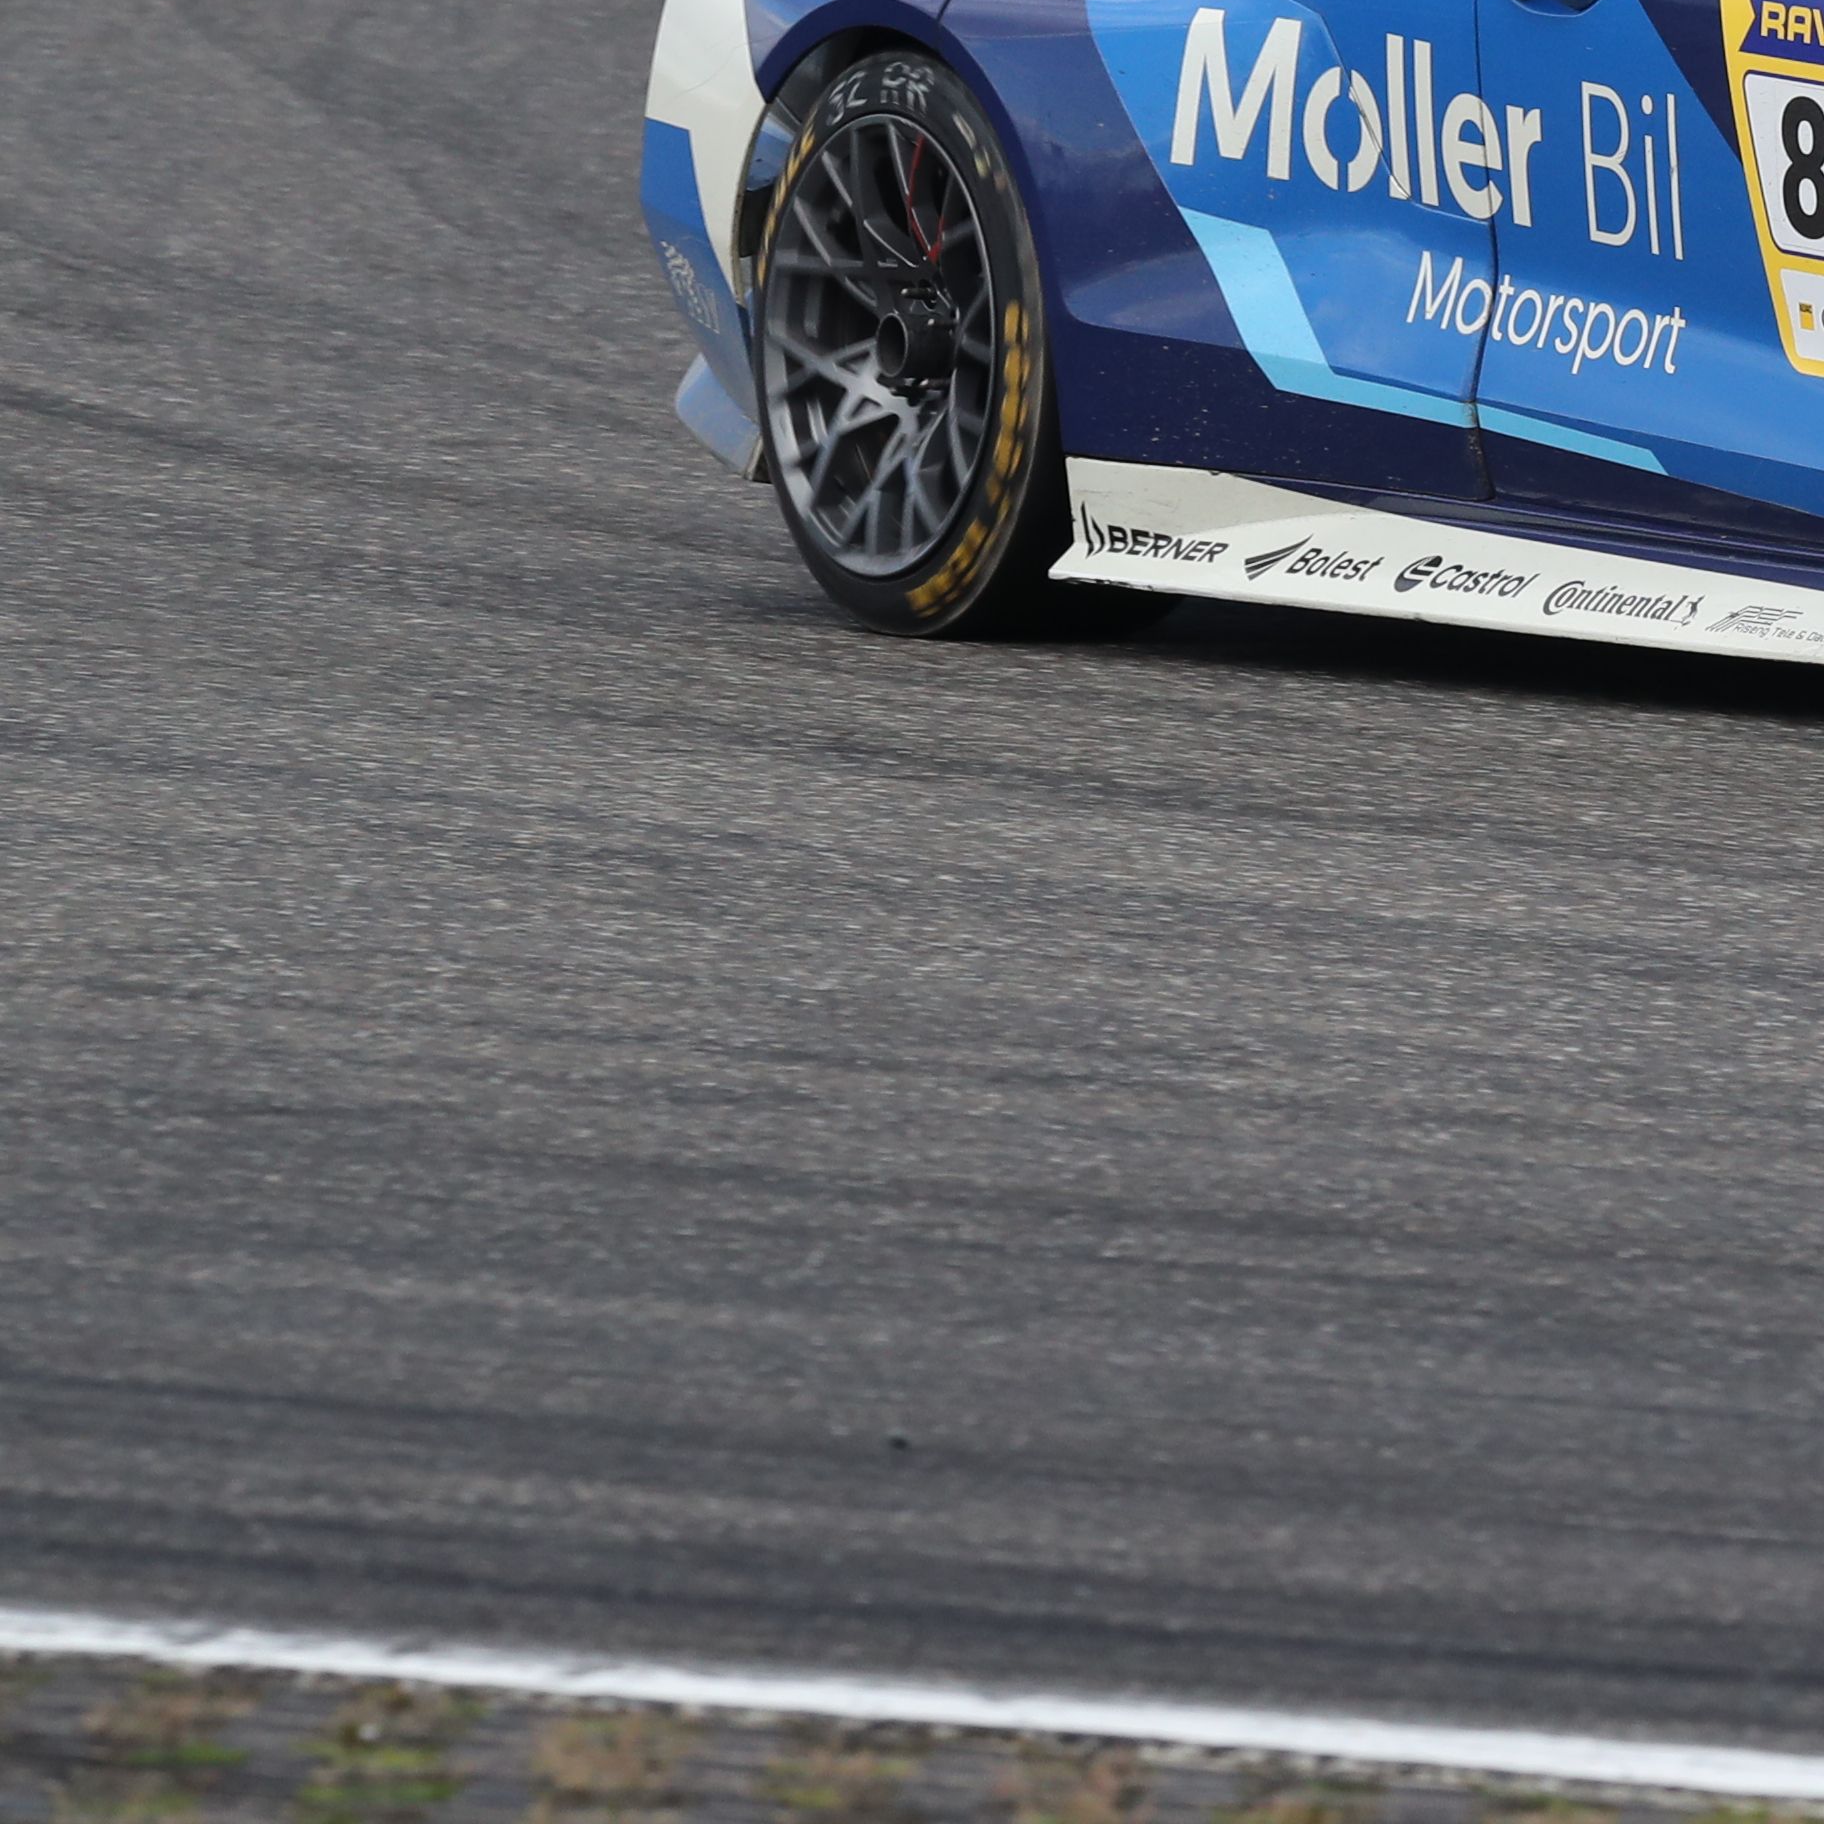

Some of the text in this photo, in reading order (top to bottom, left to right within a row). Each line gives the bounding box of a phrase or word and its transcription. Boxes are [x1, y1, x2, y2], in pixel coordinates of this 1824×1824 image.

[1581, 81, 1685, 261] Bil
[1406, 250, 1687, 375] Motorsport
[1107, 524, 1230, 564] BERNER
[1286, 547, 1385, 582] Bolest
[1430, 565, 1541, 599] Castrol
[1542, 580, 1686, 625] Continental
